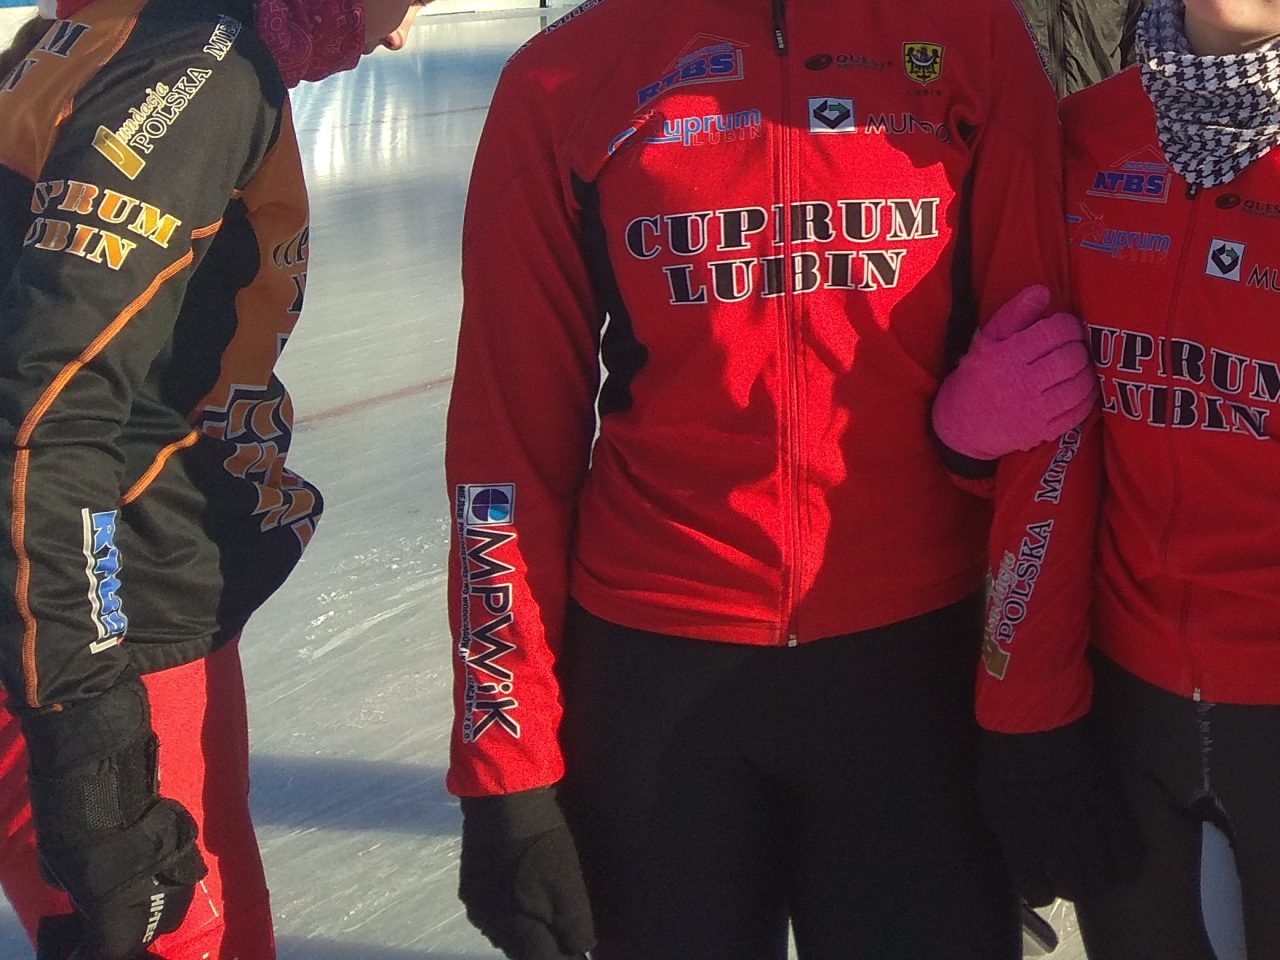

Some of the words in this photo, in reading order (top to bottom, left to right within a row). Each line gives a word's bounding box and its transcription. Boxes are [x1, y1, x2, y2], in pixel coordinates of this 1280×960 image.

[130, 68, 212, 153] POLSKA
[625, 197, 941, 260] CUPRUM
[662, 249, 907, 305] LUBIN
[996, 519, 1054, 643] POLSKA
